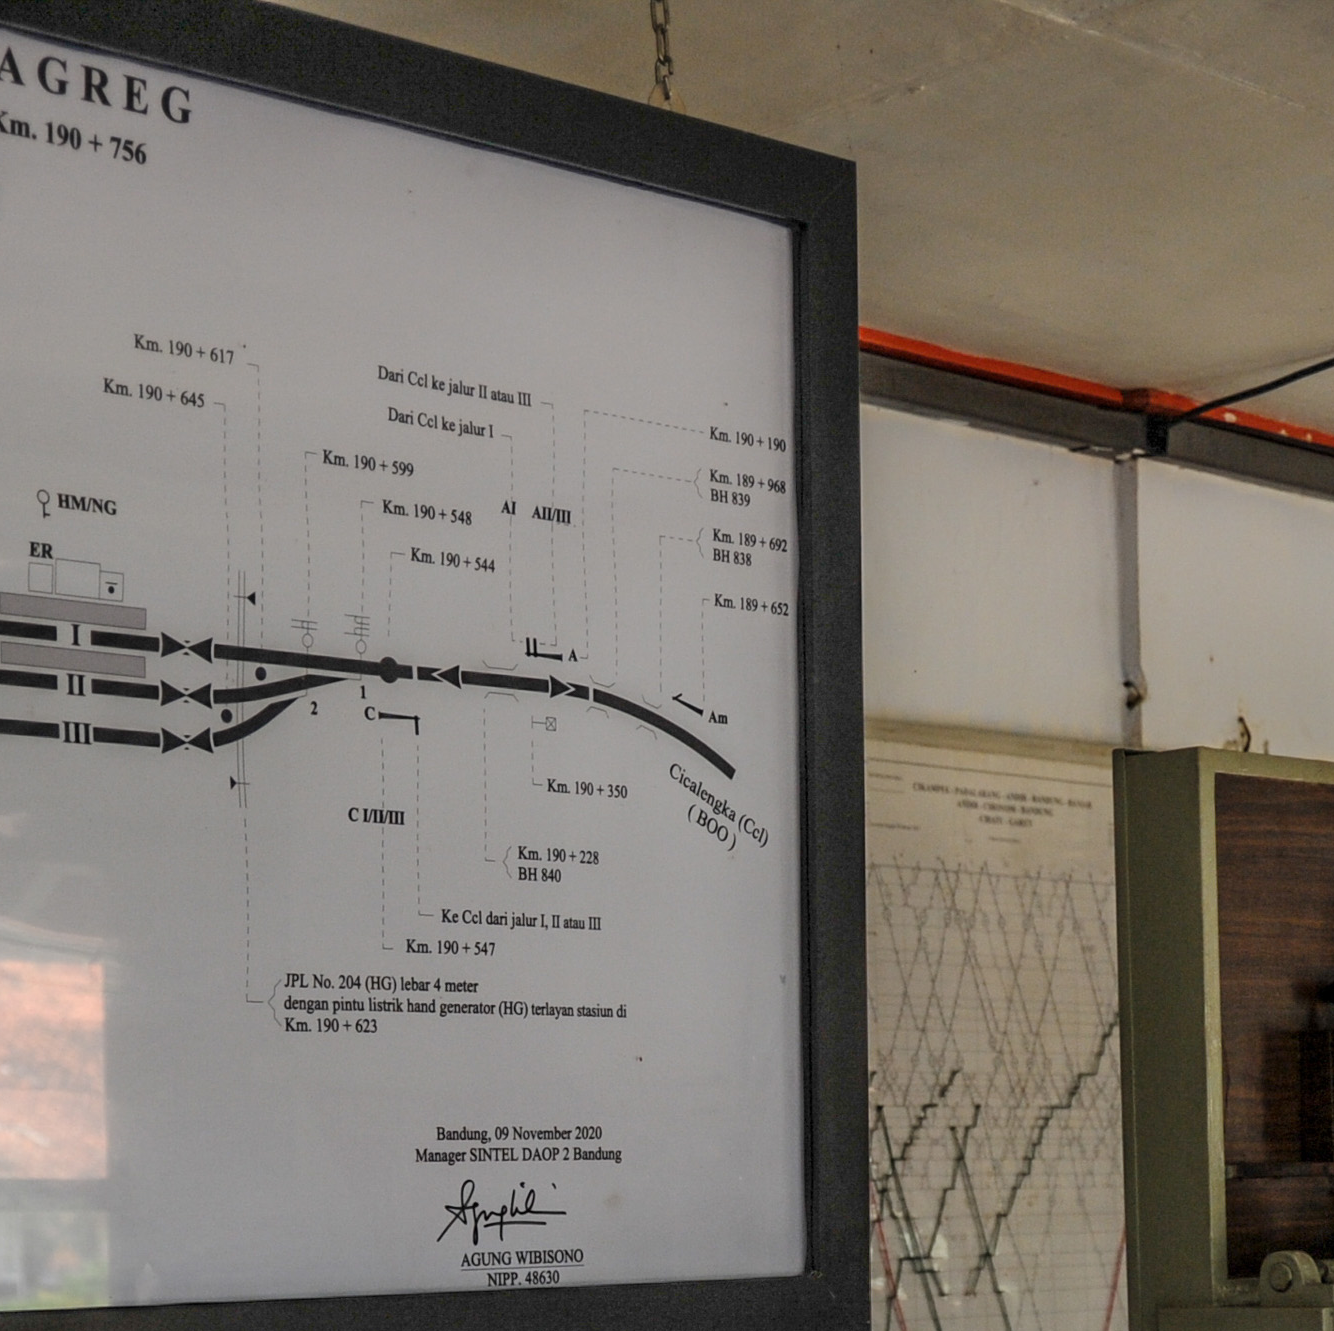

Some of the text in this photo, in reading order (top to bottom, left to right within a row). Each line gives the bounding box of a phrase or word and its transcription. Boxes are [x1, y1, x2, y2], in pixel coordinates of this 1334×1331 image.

[45, 122, 82, 151] 190
[109, 137, 147, 165] 756
[57, 492, 118, 516] HM/NG
[29, 542, 53, 559] ER
[669, 763, 768, 848] Cicalengka (Ccl)
[518, 867, 561, 883] BH 840
[284, 973, 478, 994] JPL No. 204 (HG) lebar 4 meter
[284, 997, 626, 1020] dengan pintu listrik hand generator (HG) terlayan stasiun di
[436, 1126, 602, 1143] Bandung, 09 November 2020
[415, 1147, 622, 1165] Manager SINTEL DAOP 2 Bandung
[461, 1249, 584, 1267] AGUNG WIBISONO
[487, 1270, 560, 1287] NIPP. 48630
